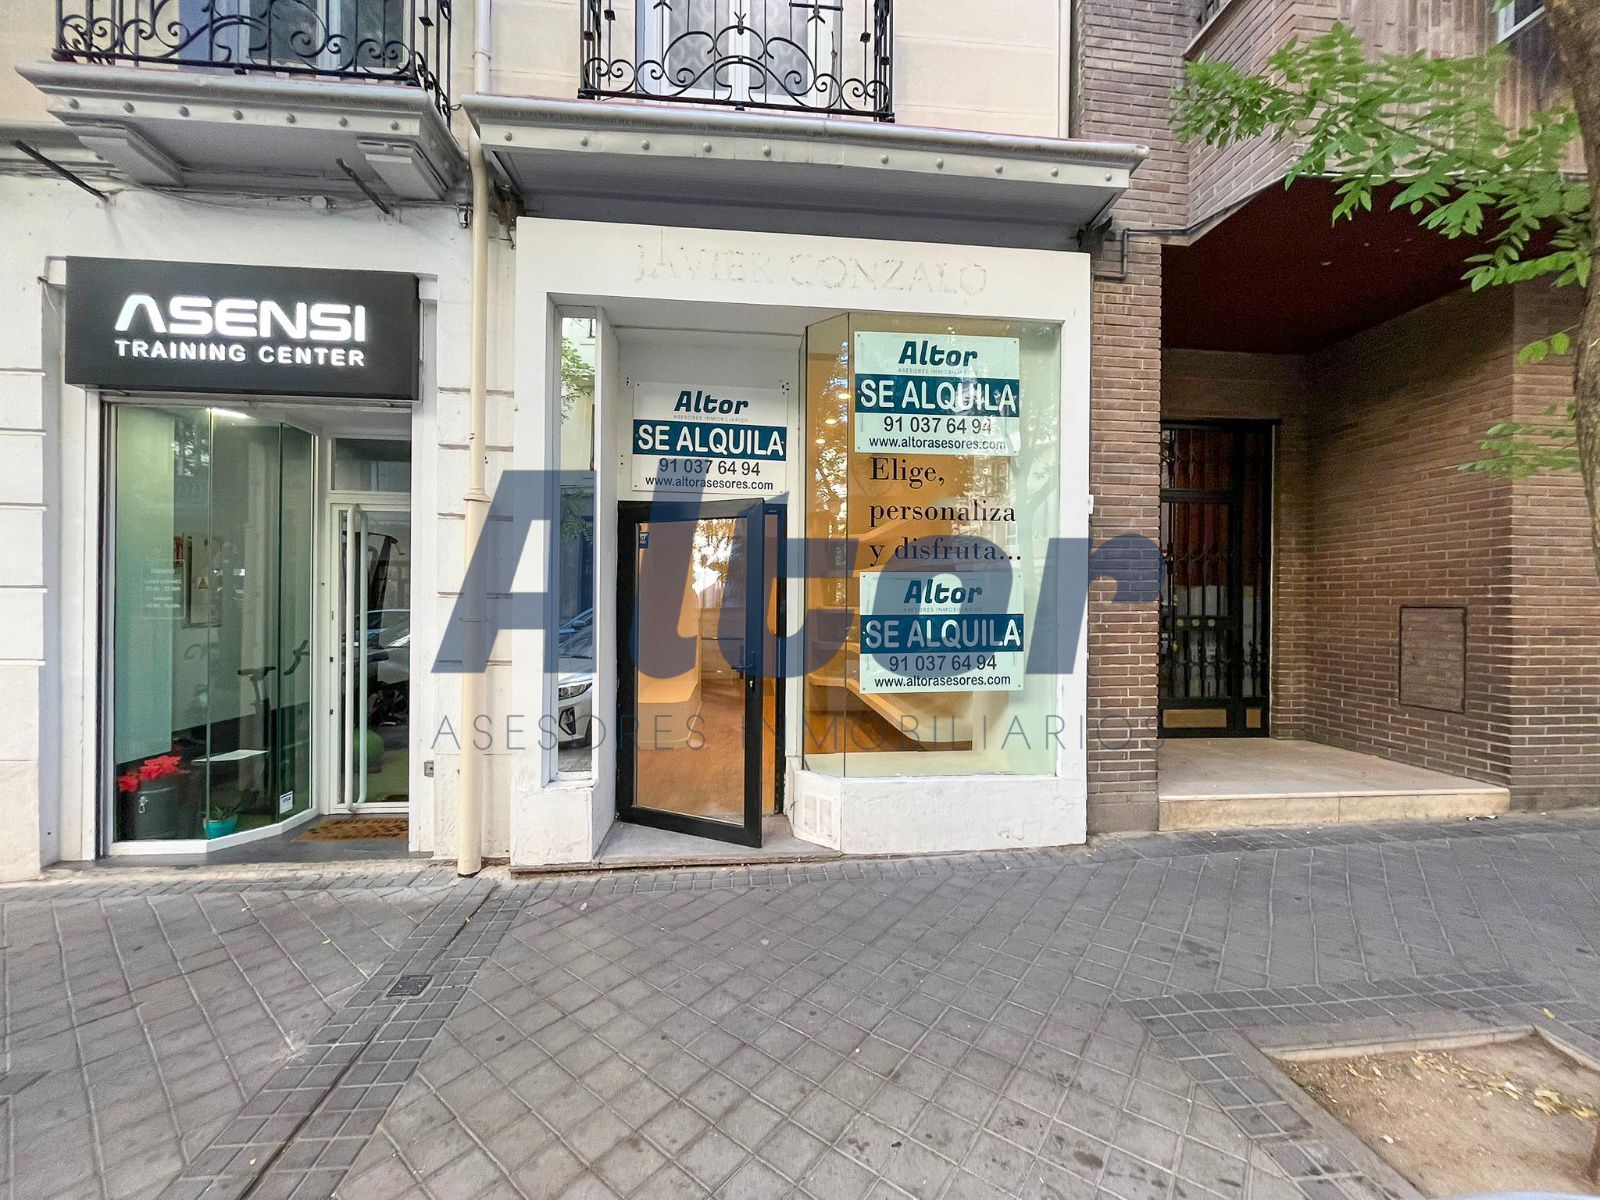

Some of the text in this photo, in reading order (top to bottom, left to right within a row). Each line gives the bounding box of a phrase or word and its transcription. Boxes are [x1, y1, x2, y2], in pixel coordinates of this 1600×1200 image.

[114, 293, 367, 342] ASENSI
[115, 339, 366, 368] TRAINING CENTER
[898, 340, 978, 367] Altor
[674, 390, 749, 414] Altor
[860, 379, 1017, 415] SE ALQUILA
[883, 416, 992, 435] 91 037 64 94
[638, 424, 784, 456] SE ALQUILA
[869, 436, 1006, 451] www.altorasesores.com
[659, 457, 761, 477] 91 037 64 94
[869, 456, 945, 489] Elige,
[645, 475, 774, 491] www.altorasesores.com
[869, 499, 1016, 528] personaliza
[869, 536, 1022, 567] y disfruta...
[903, 578, 983, 604] Altor
[865, 618, 1021, 650] SE ALQUILA
[889, 654, 997, 672] 91 037 64 94
[874, 674, 1011, 689] www.altorasesores.com
